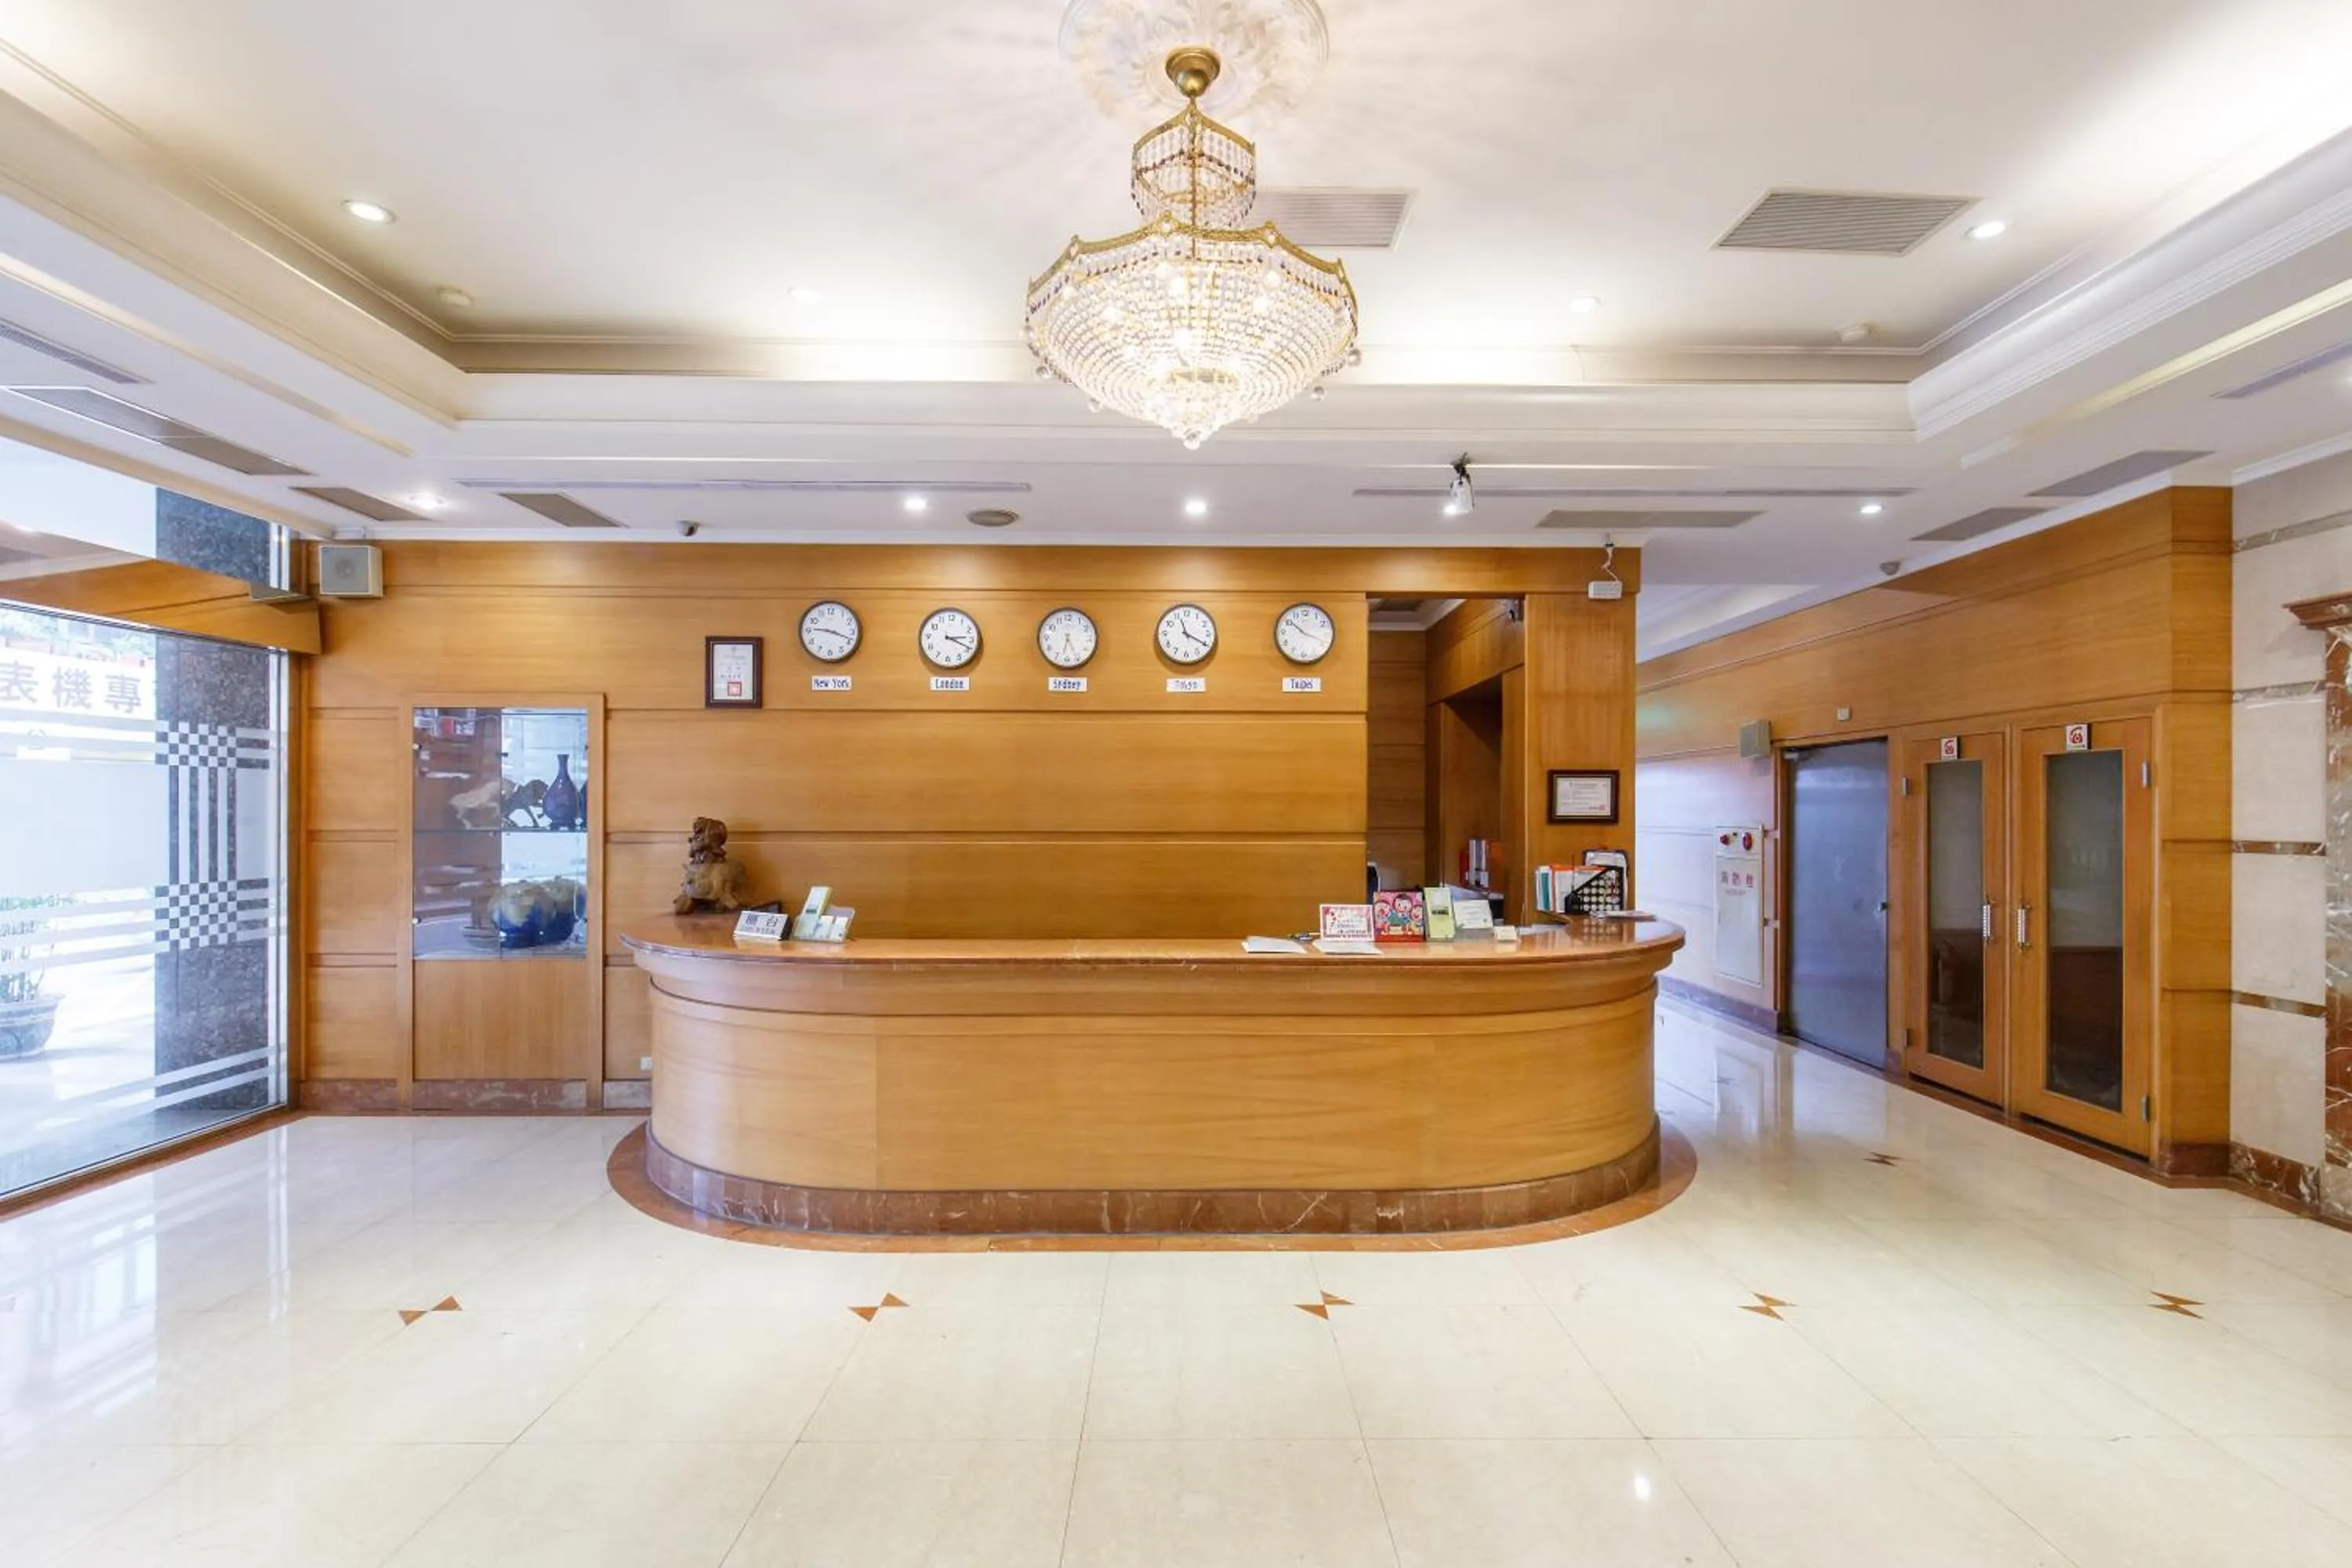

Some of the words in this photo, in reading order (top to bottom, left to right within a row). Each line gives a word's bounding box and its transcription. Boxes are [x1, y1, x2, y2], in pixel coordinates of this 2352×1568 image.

[0, 660, 157, 713] 表機專
[935, 678, 964, 689] London
